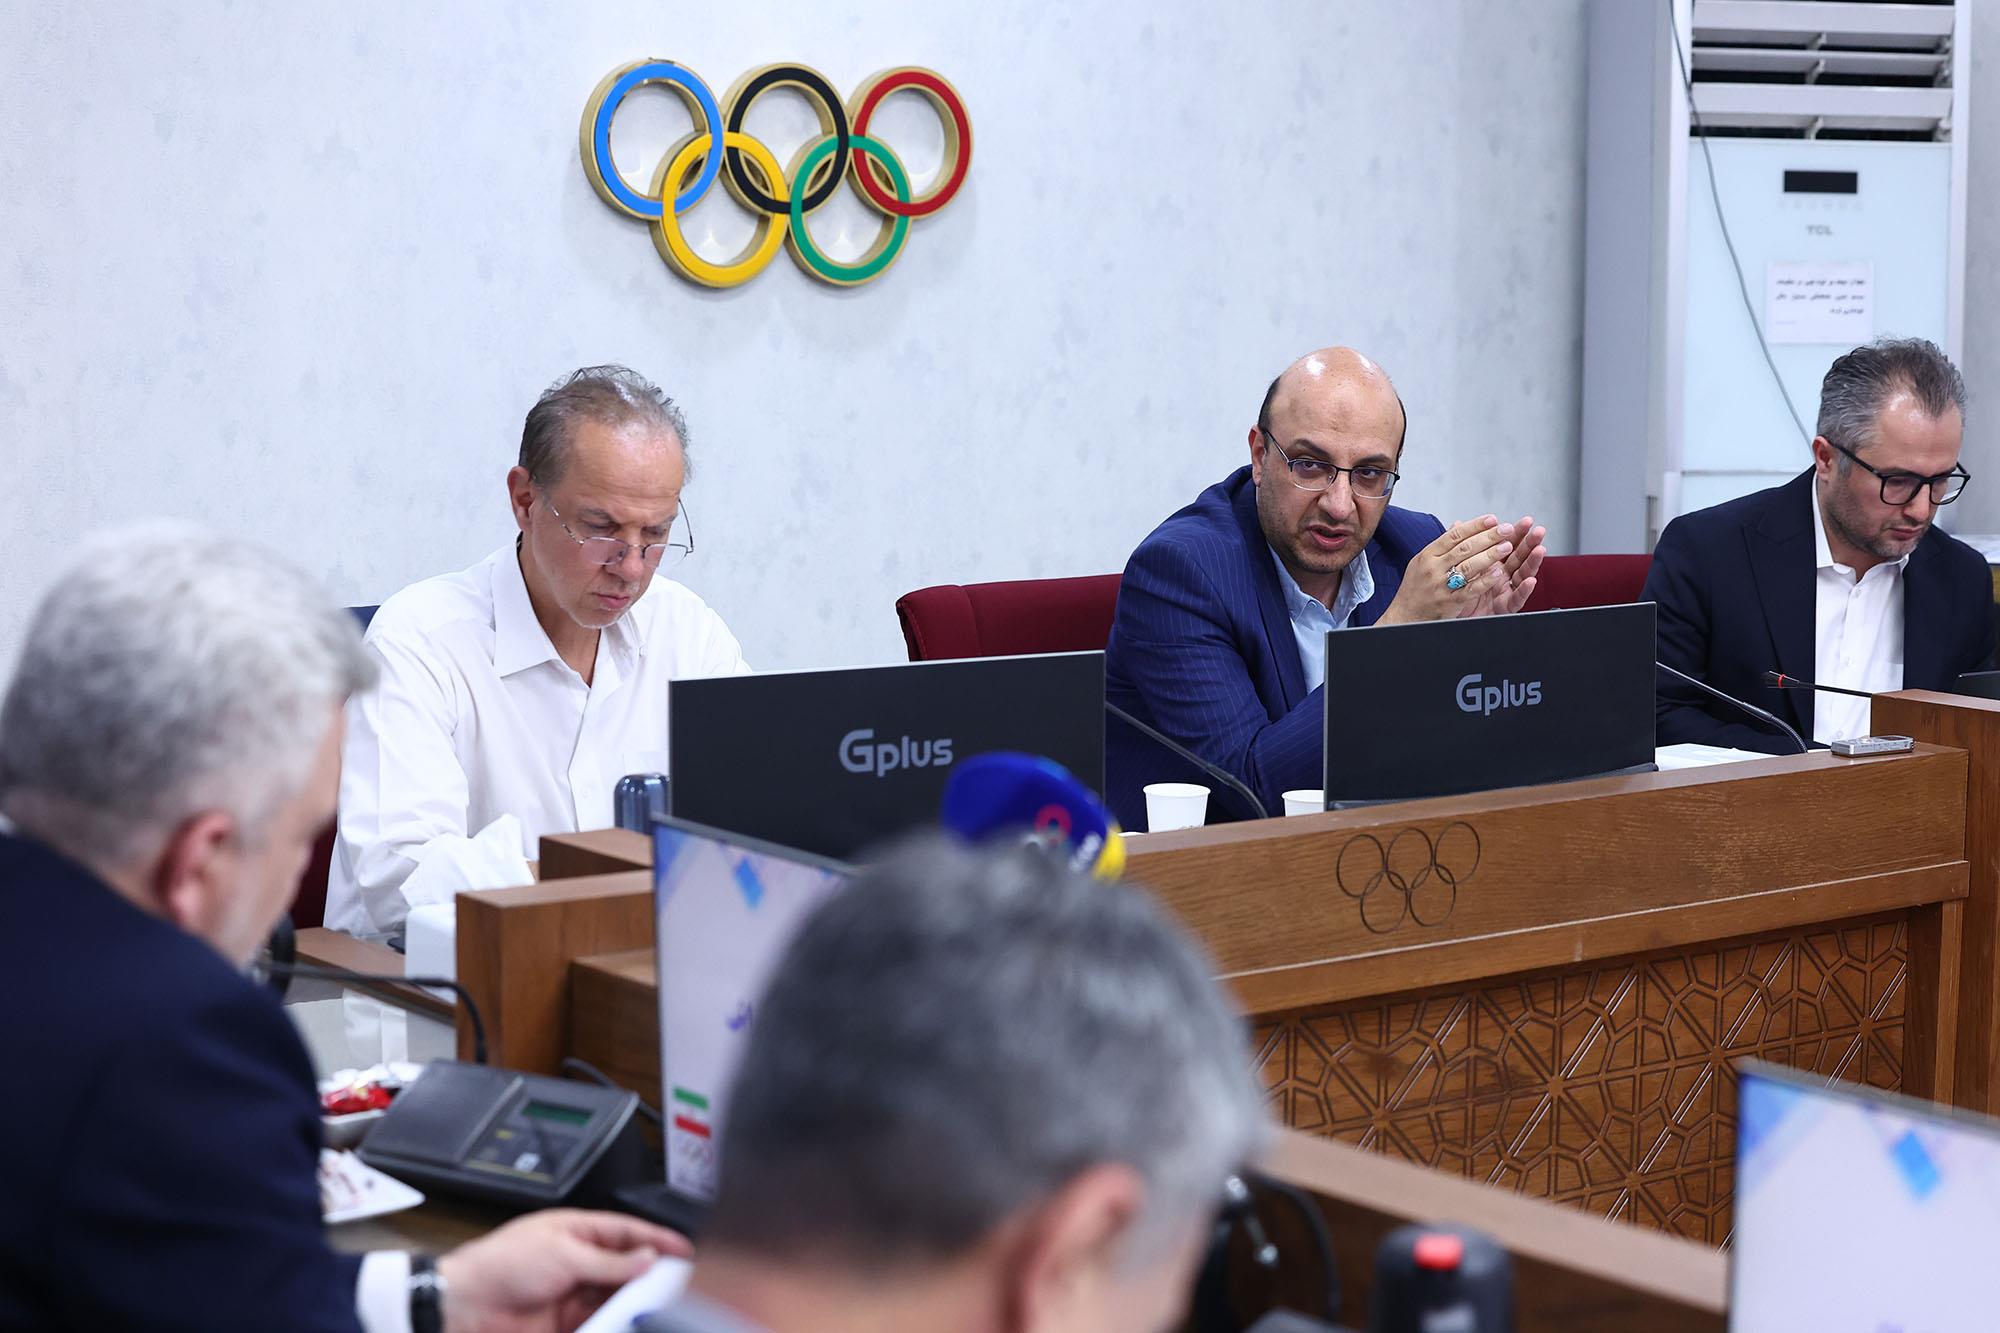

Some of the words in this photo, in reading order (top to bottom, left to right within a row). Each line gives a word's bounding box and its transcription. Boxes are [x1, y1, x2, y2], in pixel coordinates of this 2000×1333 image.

[1806, 225, 1833, 236] TCL
[1456, 673, 1542, 716] Gplus
[838, 729, 954, 777] Gplus
